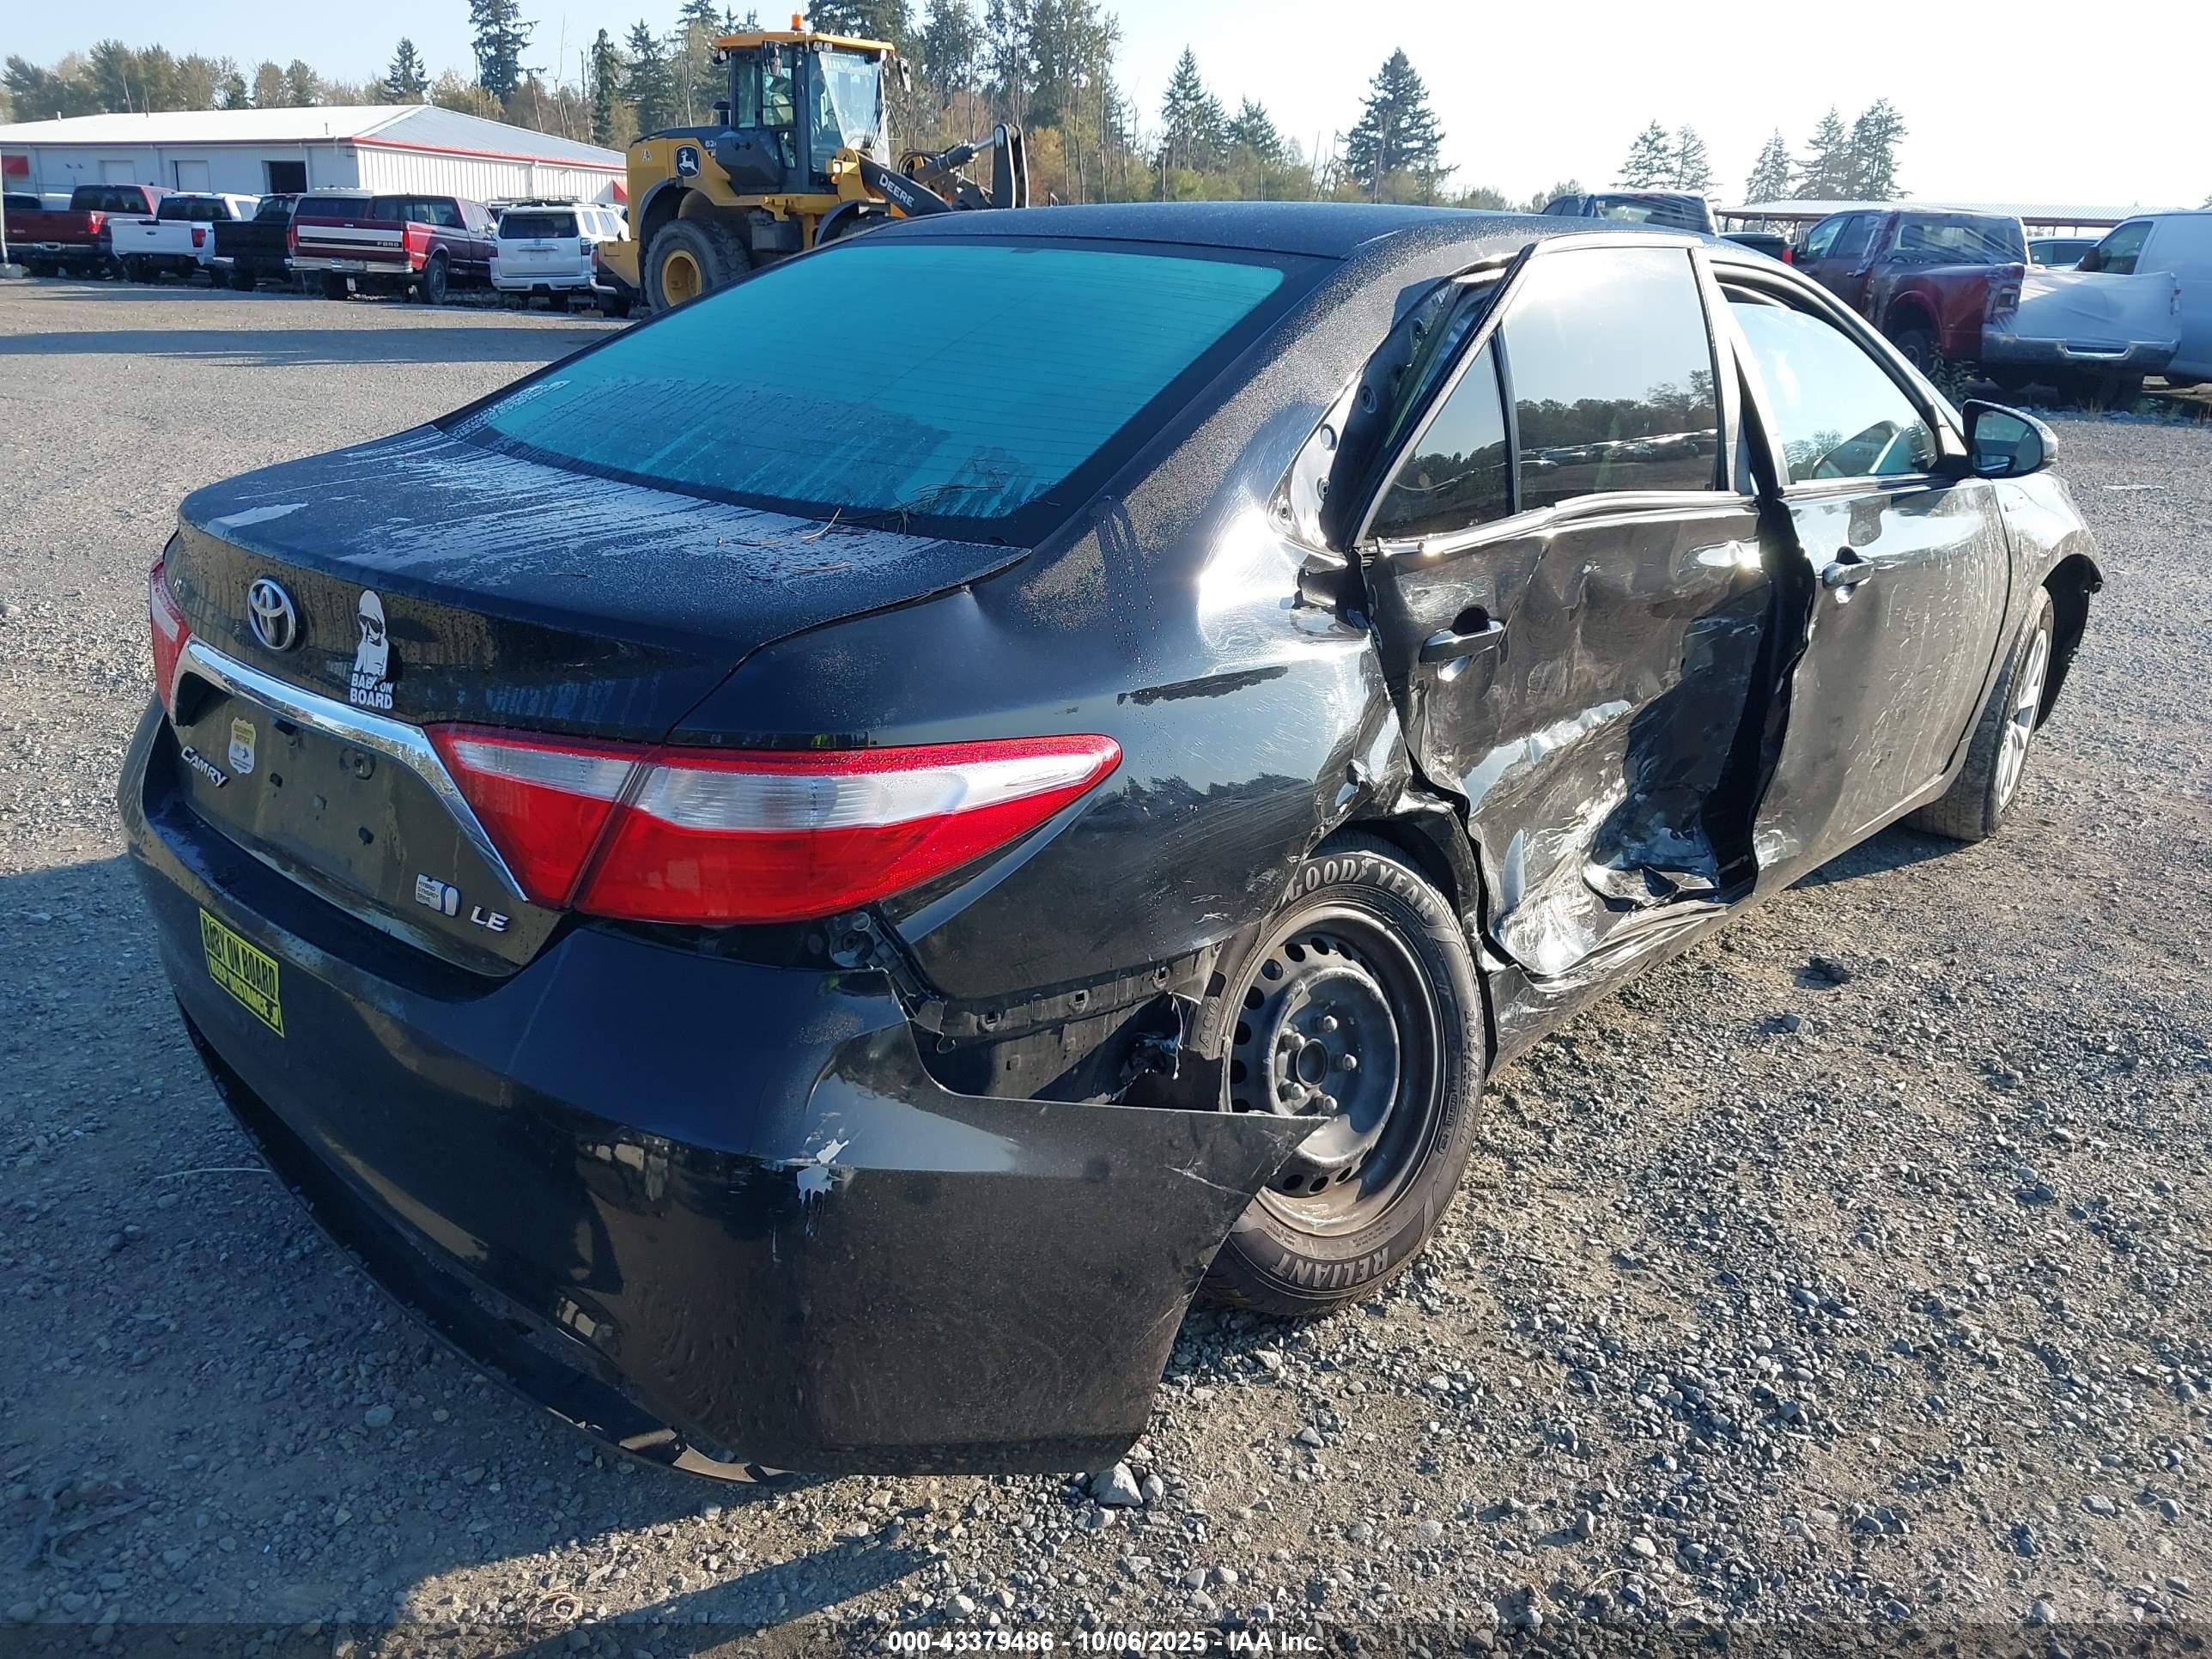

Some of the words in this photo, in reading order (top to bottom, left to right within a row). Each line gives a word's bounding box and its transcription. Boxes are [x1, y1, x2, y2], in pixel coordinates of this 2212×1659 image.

[879, 173, 915, 207] DEERE
[349, 687, 393, 709] BOARD
[380, 681, 393, 694] ON
[180, 745, 228, 787] CAMRY
[471, 905, 509, 932] LE
[202, 915, 226, 964] BABY
[227, 936, 242, 976] ON
[241, 947, 276, 1001] BOARD
[1270, 1247, 1389, 1288] RELIANT
